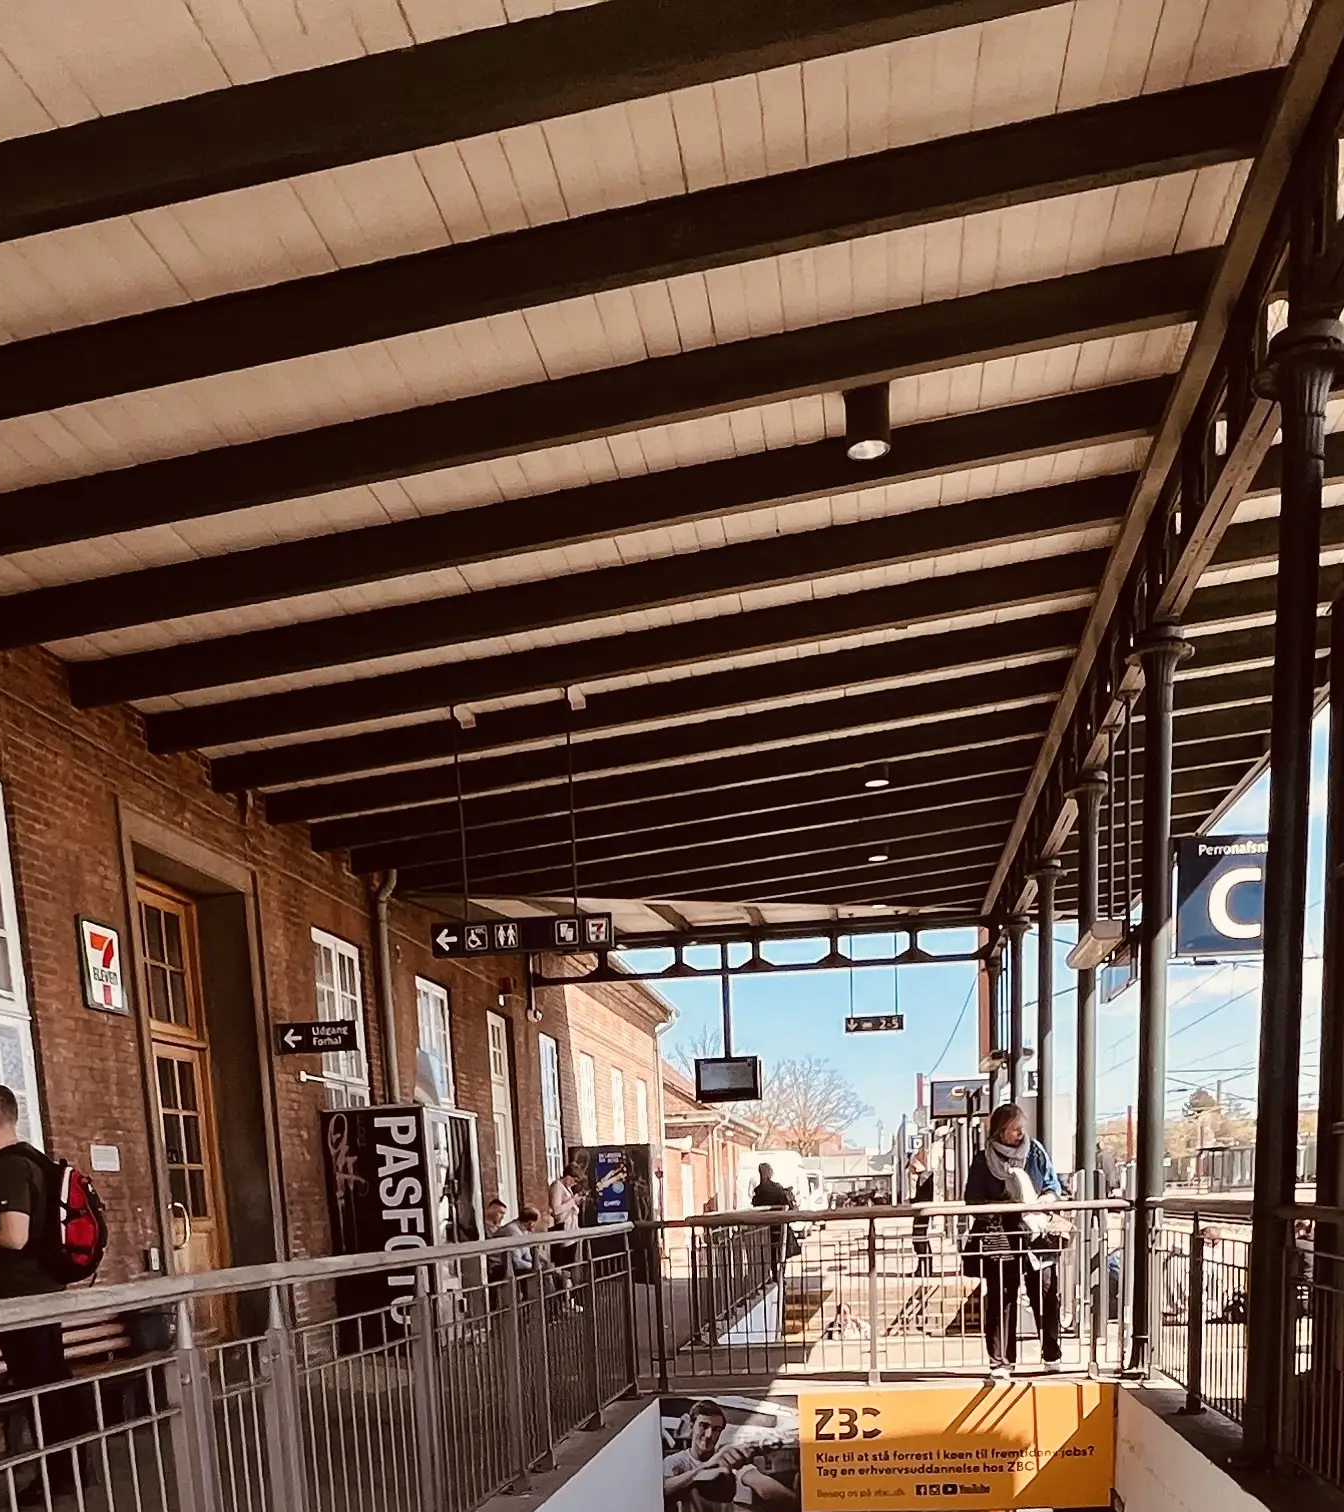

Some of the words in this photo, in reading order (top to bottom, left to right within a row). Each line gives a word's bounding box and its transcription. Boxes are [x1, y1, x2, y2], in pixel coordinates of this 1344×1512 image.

[1198, 840, 1268, 856] Perronafsni
[1208, 867, 1262, 939] C
[311, 1026, 349, 1036] Udgang
[816, 1453, 840, 1463] Klar
[842, 1452, 854, 1462] til
[857, 1452, 869, 1461] at
[871, 1450, 890, 1461] stå
[893, 1449, 934, 1460] forrest
[975, 1448, 988, 1459] til
[1061, 1445, 1095, 1459] jobs?
[816, 1466, 838, 1478] Tag
[858, 1462, 980, 1475] erhvervsuddannelse
[983, 1462, 1004, 1473] hos
[1007, 1461, 1035, 1472] ZBC
